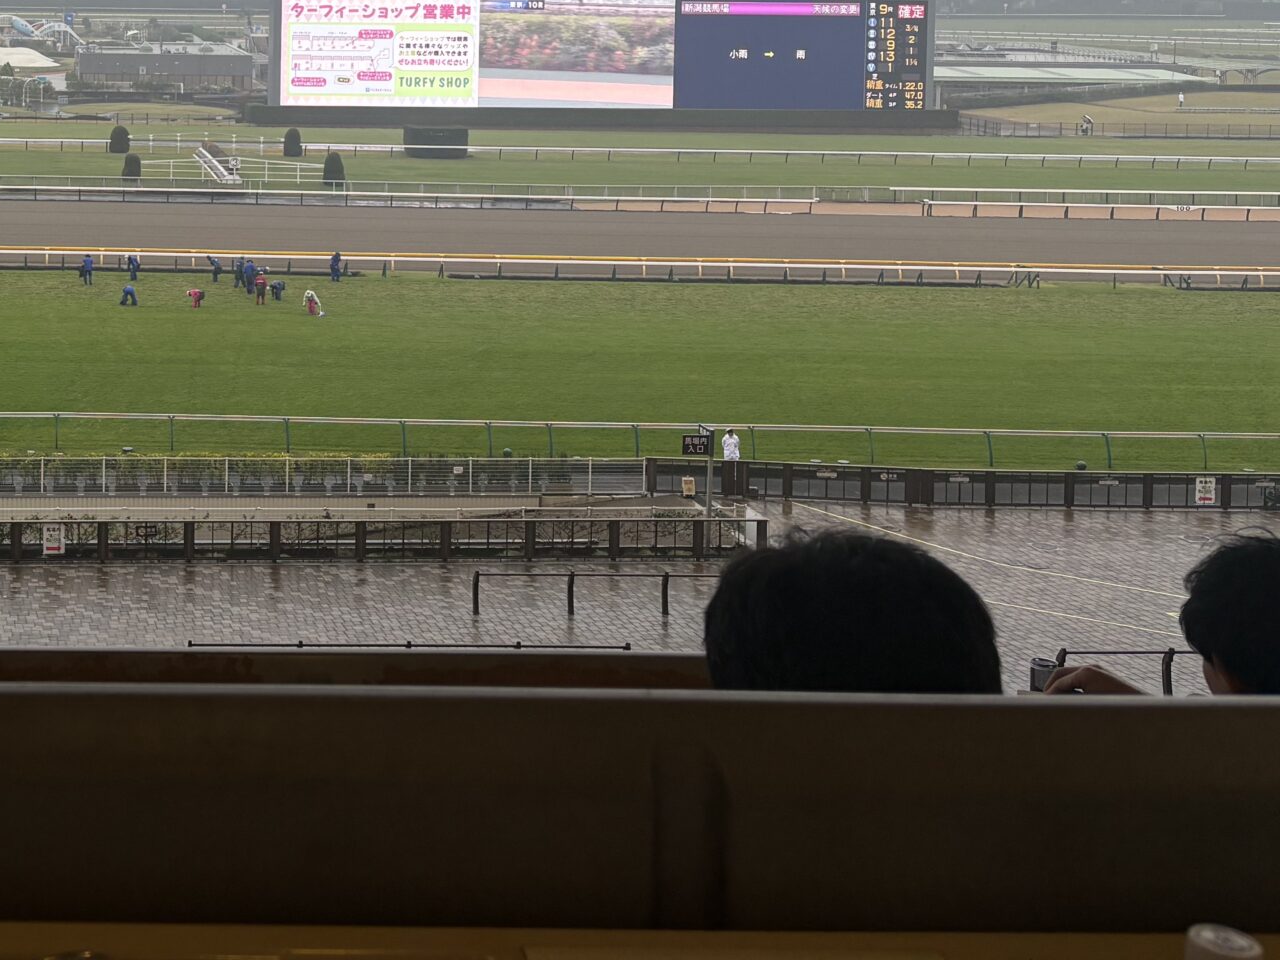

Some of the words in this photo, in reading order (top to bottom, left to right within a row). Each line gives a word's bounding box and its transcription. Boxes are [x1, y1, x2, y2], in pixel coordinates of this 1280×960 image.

[290, 2, 472, 20] ターフィーショップ営業中
[684, 3, 729, 13] 新潟競馬場
[813, 4, 858, 14] 天候の変更
[869, 2, 876, 16] 東京
[898, 5, 925, 19] 確定
[880, 29, 896, 39] 12
[908, 35, 915, 44] 2
[886, 40, 896, 50] 9
[729, 49, 748, 59] 小雨
[796, 49, 806, 59] 雨
[880, 51, 895, 62] 13
[399, 76, 436, 88] TURFY
[439, 77, 470, 88] SHOP
[899, 82, 923, 90] 1.22.0
[866, 91, 883, 99] ダート
[905, 91, 923, 99] 47.0
[905, 100, 923, 109] 35.2
[687, 445, 704, 453] 入口
